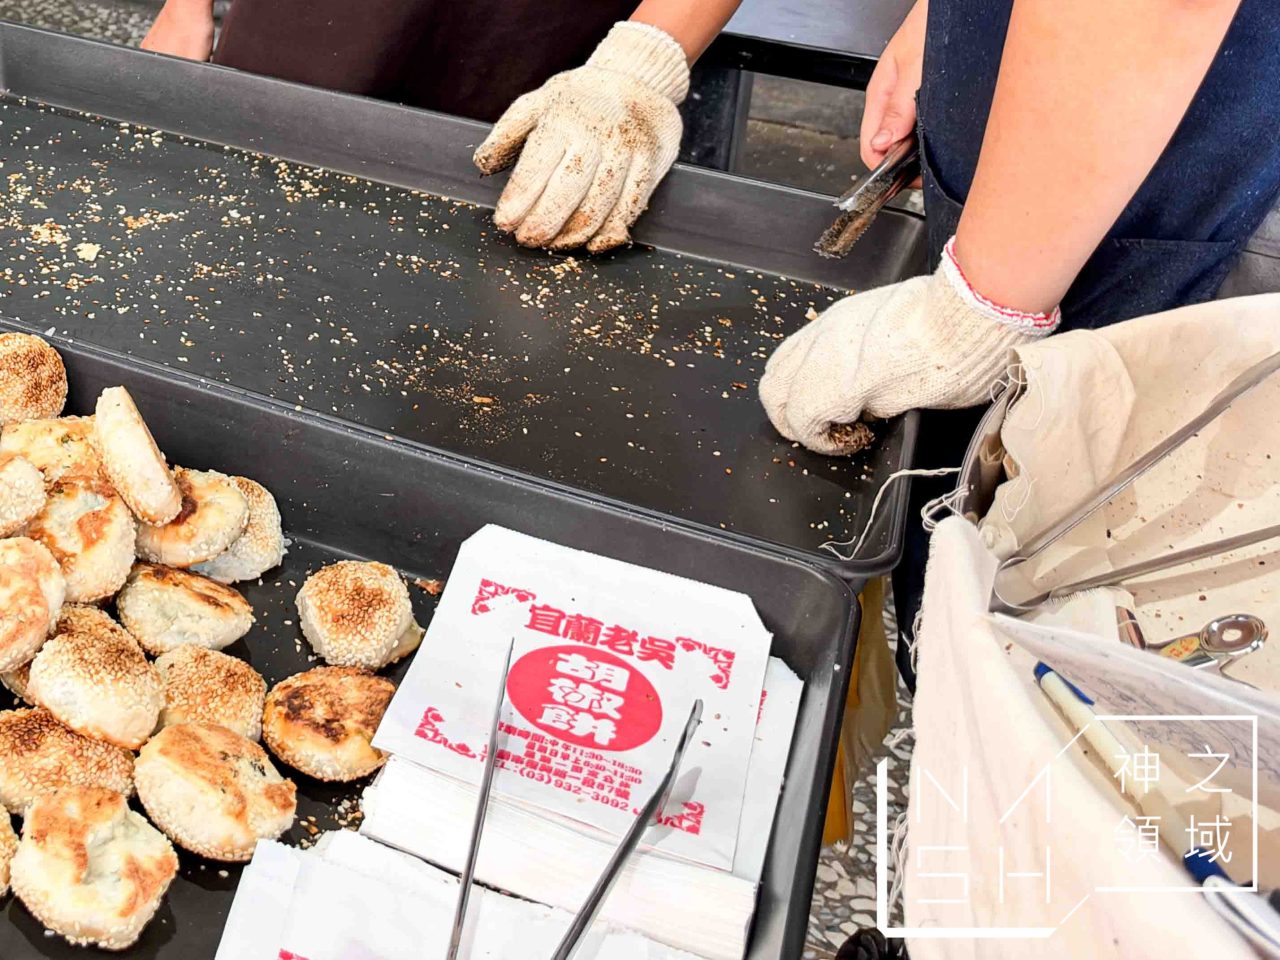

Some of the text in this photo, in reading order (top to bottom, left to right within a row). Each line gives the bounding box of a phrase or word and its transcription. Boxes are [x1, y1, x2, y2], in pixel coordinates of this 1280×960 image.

[524, 604, 676, 670] 宜蘭老吳
[536, 652, 631, 746] 胡椒餅
